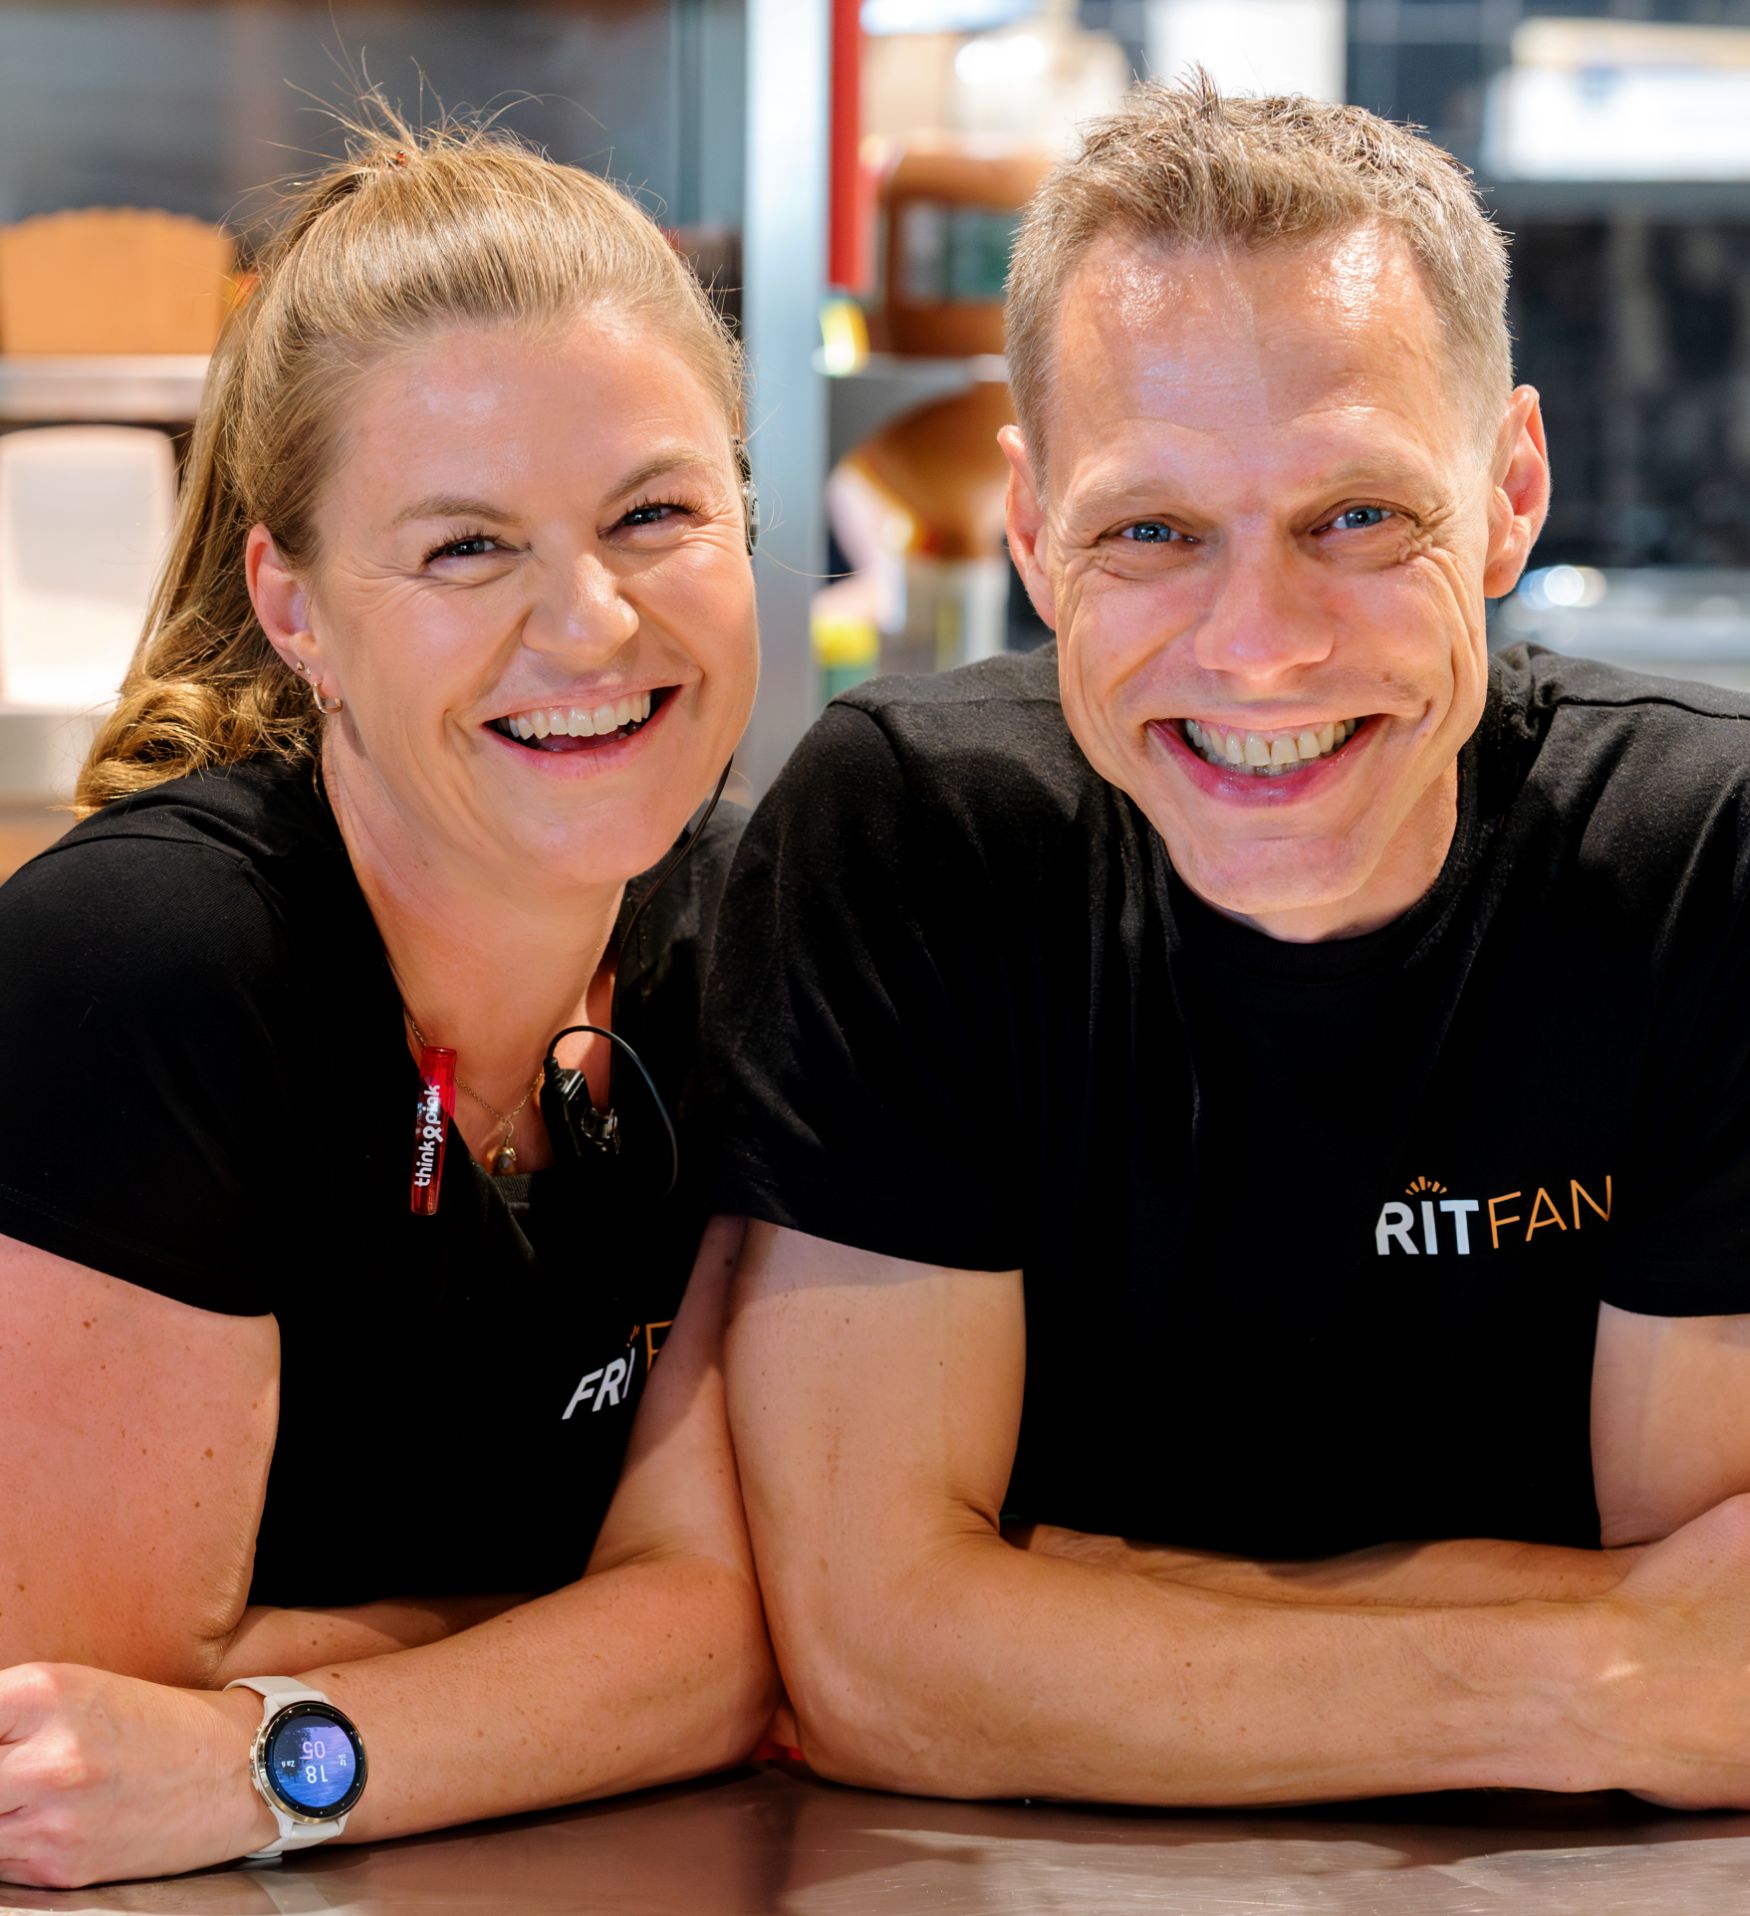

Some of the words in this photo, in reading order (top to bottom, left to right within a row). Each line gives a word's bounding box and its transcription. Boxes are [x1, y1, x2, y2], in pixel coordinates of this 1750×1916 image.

[422, 1085, 442, 1125] pink
[414, 1140, 436, 1187] think
[299, 1740, 326, 1760] 05
[305, 1765, 328, 1784] 18
